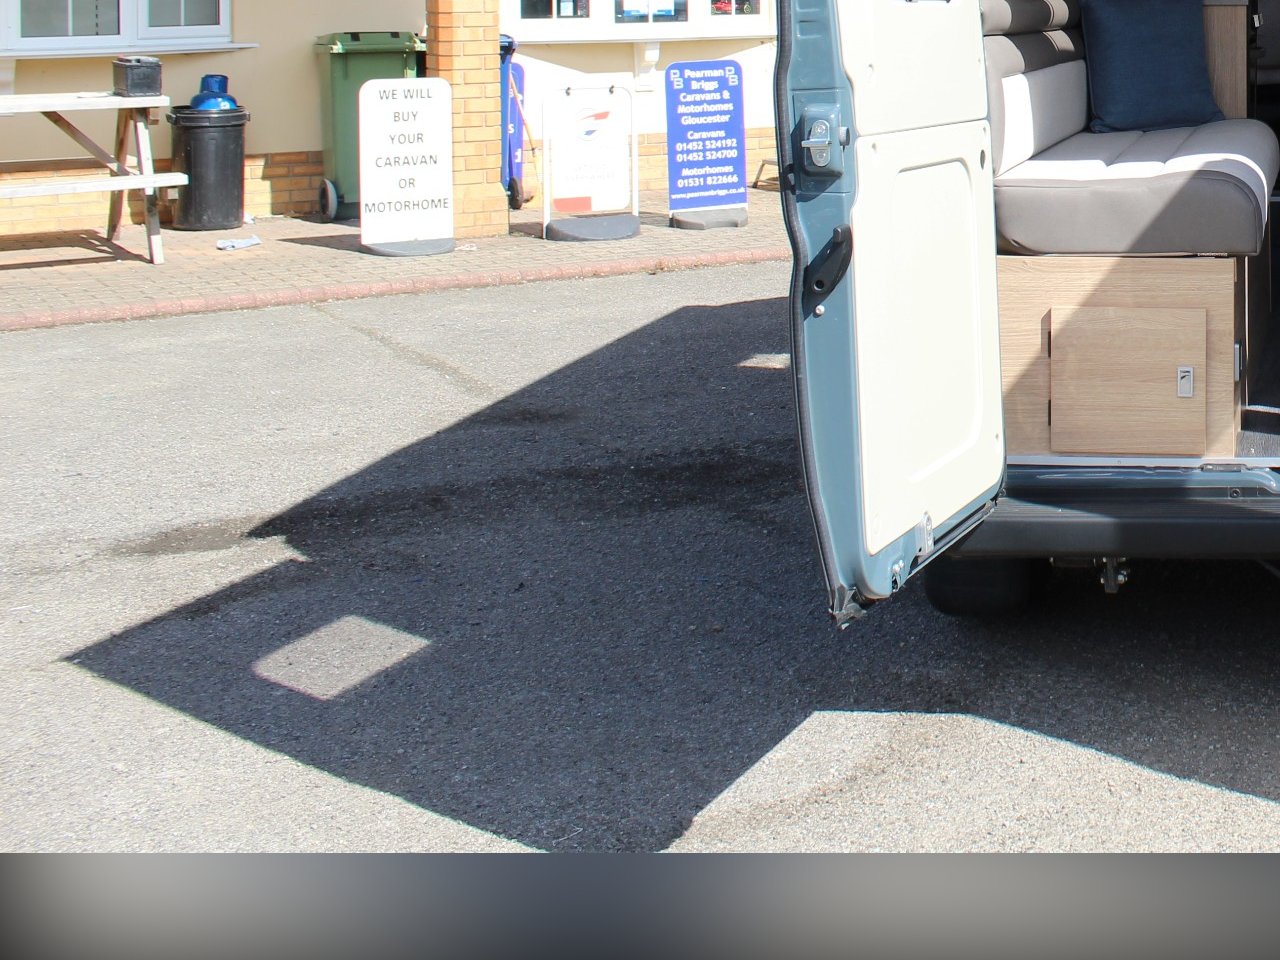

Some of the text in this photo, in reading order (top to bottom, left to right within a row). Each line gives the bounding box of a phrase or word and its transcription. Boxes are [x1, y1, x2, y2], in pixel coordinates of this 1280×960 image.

[684, 69, 724, 79] Pearman
[691, 80, 719, 91] Briggs
[379, 88, 432, 100] WE WILL
[680, 90, 731, 102] Caravans &
[677, 102, 734, 114] Motorhomes
[393, 111, 418, 122] BUY
[681, 114, 731, 126] Gloucester
[389, 133, 424, 144] YOUR
[687, 130, 726, 140] Caravans
[676, 138, 738, 152] 01452 524192
[375, 154, 438, 168] CARAVAN
[676, 149, 738, 162] 01452 524700
[681, 165, 734, 177] Motorhomes
[398, 178, 416, 189] OR
[677, 174, 739, 188] 01531 822666
[364, 197, 449, 214] MOTORHOME
